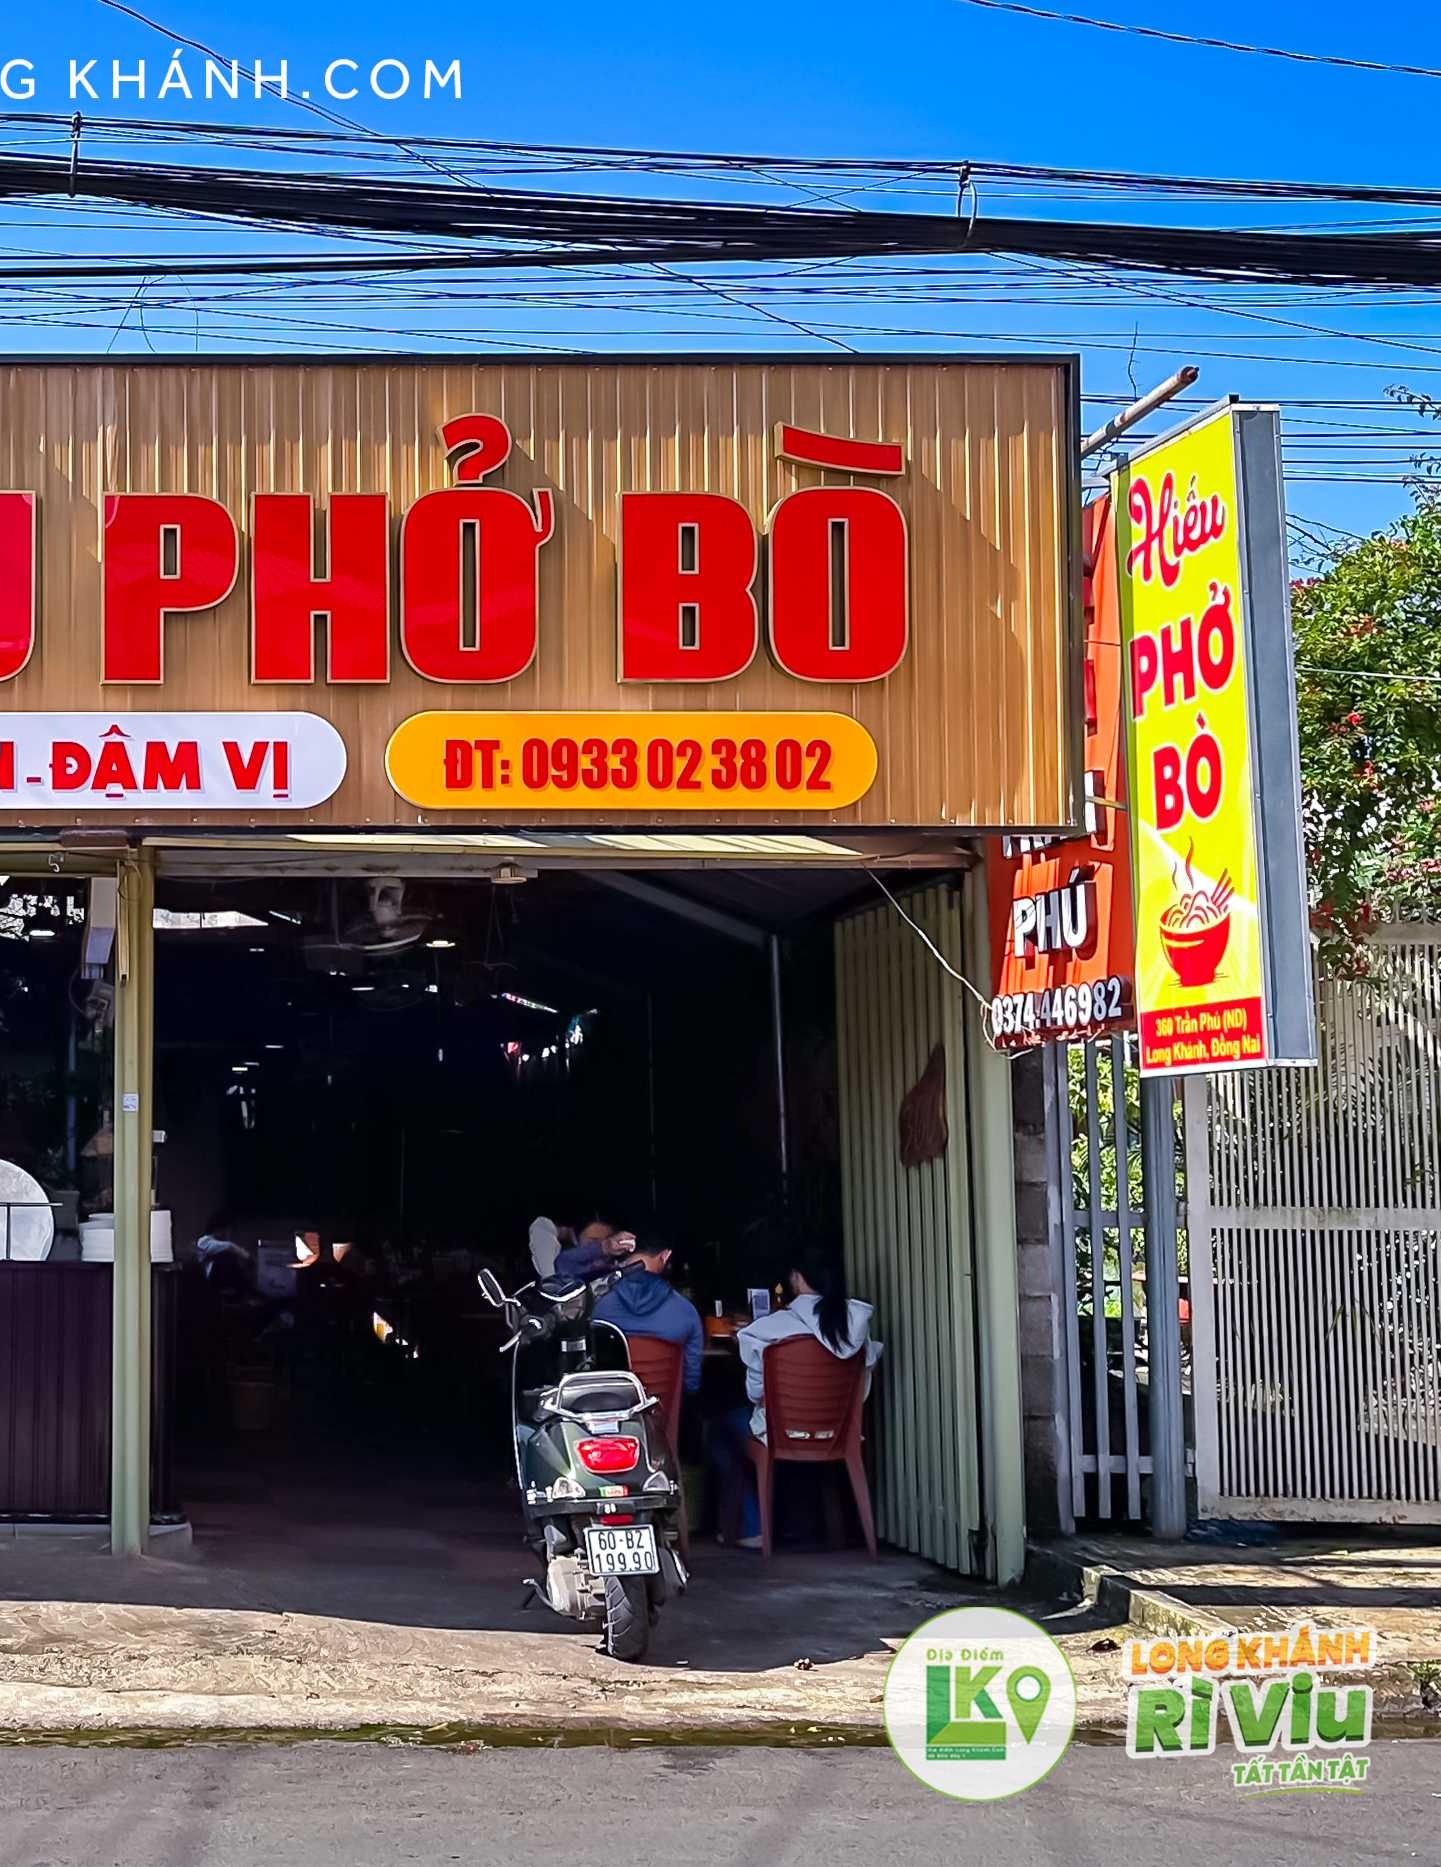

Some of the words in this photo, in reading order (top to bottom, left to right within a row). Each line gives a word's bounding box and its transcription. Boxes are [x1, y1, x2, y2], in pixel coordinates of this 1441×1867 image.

[101, 413, 555, 685] PHỞ
[617, 421, 910, 685] BÒ
[1126, 472, 1226, 588] Hiếu
[1129, 581, 1236, 720] PHỞ
[222, 740, 290, 799] VỊ
[444, 739, 511, 790] ĐT:
[1153, 712, 1224, 831] BÒ
[1013, 867, 1093, 958] PHÚ
[1146, 1046, 1171, 1066] Long
[1242, 1033, 1261, 1054] Nai
